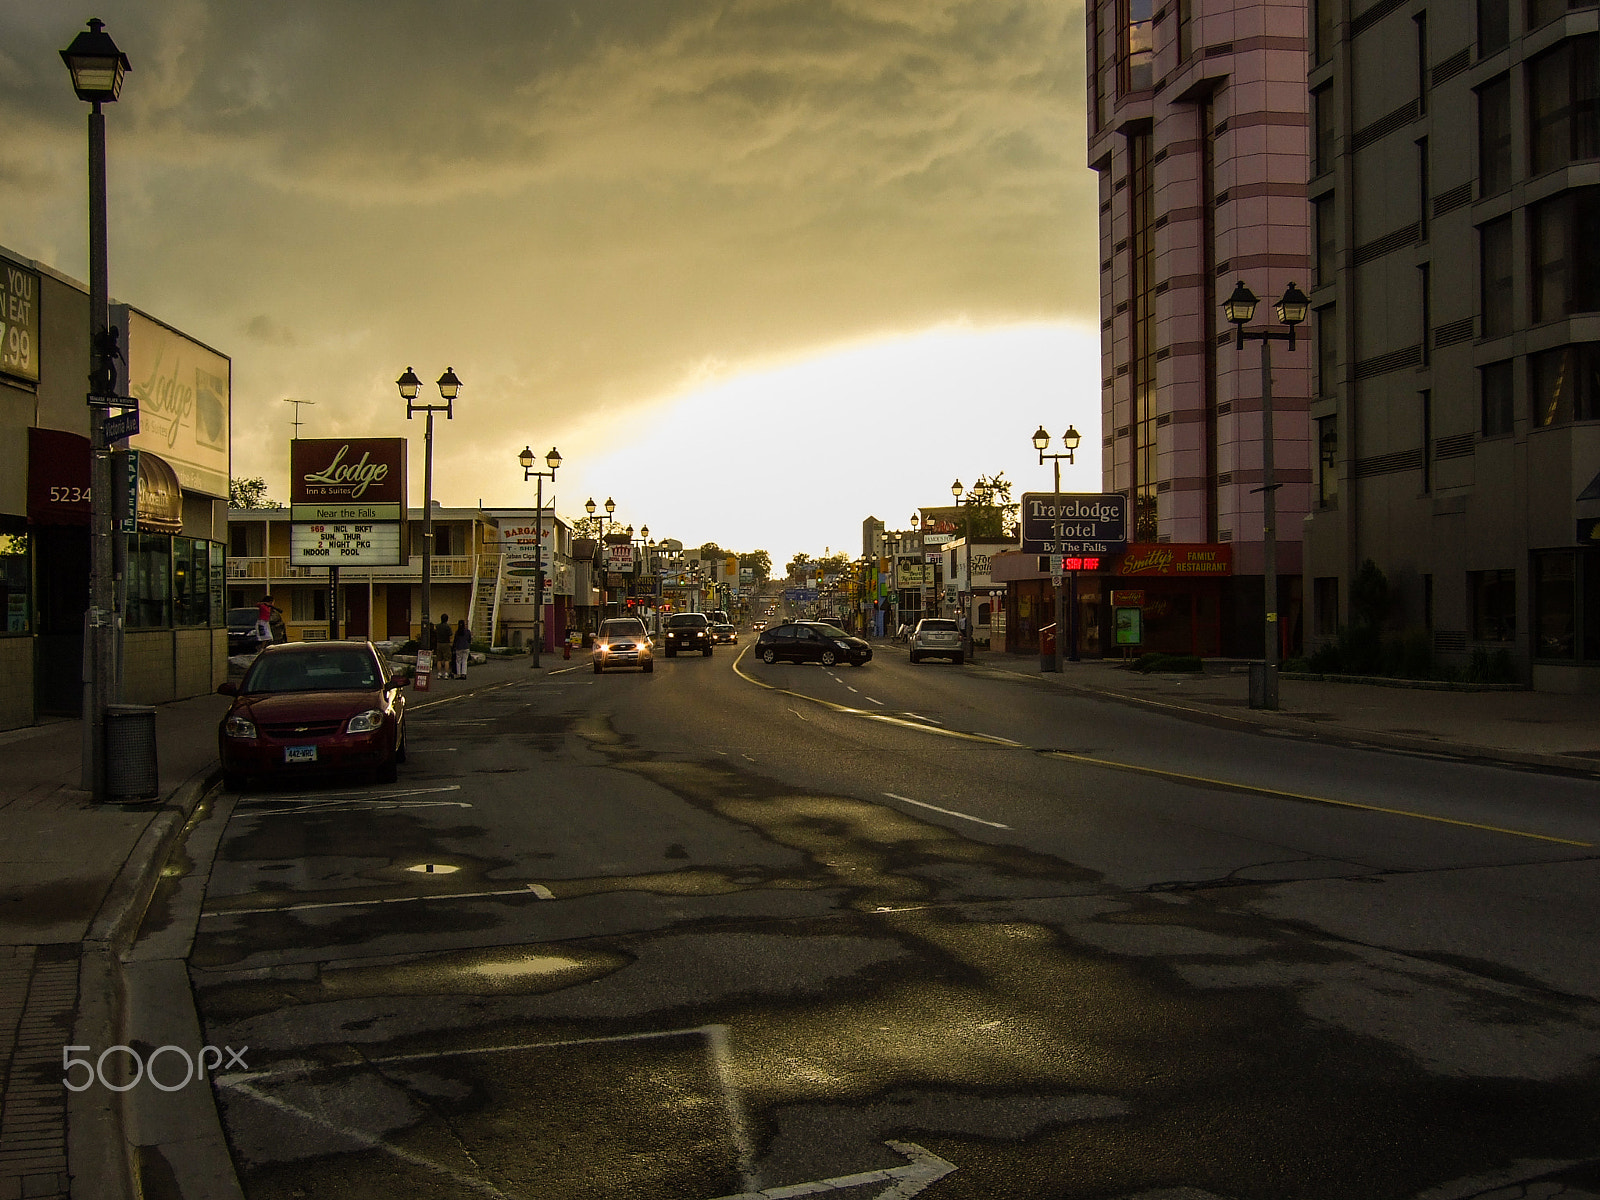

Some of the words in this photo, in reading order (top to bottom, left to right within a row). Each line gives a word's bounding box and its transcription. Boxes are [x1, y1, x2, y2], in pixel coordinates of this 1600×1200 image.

[7, 266, 32, 301] YOU
[9, 294, 31, 326] EAT
[132, 340, 193, 450] Lodge
[125, 416, 137, 432] Ave
[127, 454, 137, 484] PAY
[303, 444, 389, 500] Lodge
[50, 486, 92, 503] 5234
[306, 488, 320, 496] Inn
[320, 488, 327, 496] &
[328, 487, 352, 496] Suites
[316, 509, 337, 519] Near
[340, 509, 355, 519] the
[358, 508, 376, 519] Falls
[1029, 500, 1120, 523] Travelodge
[310, 525, 325, 534] $69
[333, 525, 348, 534] INCL
[354, 525, 373, 534] BKFT
[504, 527, 550, 539] BARGAN
[343, 533, 361, 541] THUR
[318, 541, 323, 549] 2
[328, 541, 351, 549] NIGHT
[356, 541, 371, 549] PKG
[1043, 542, 1056, 553] By
[1061, 542, 1080, 552] The
[1082, 542, 1107, 552] Falls
[303, 548, 330, 557] INDOOR
[340, 548, 360, 557] POOL
[1187, 551, 1216, 562] FAMILY
[1066, 557, 1083, 570] STAY
[1121, 549, 1174, 574] Smitty's
[1175, 562, 1227, 573] RESTAURANT
